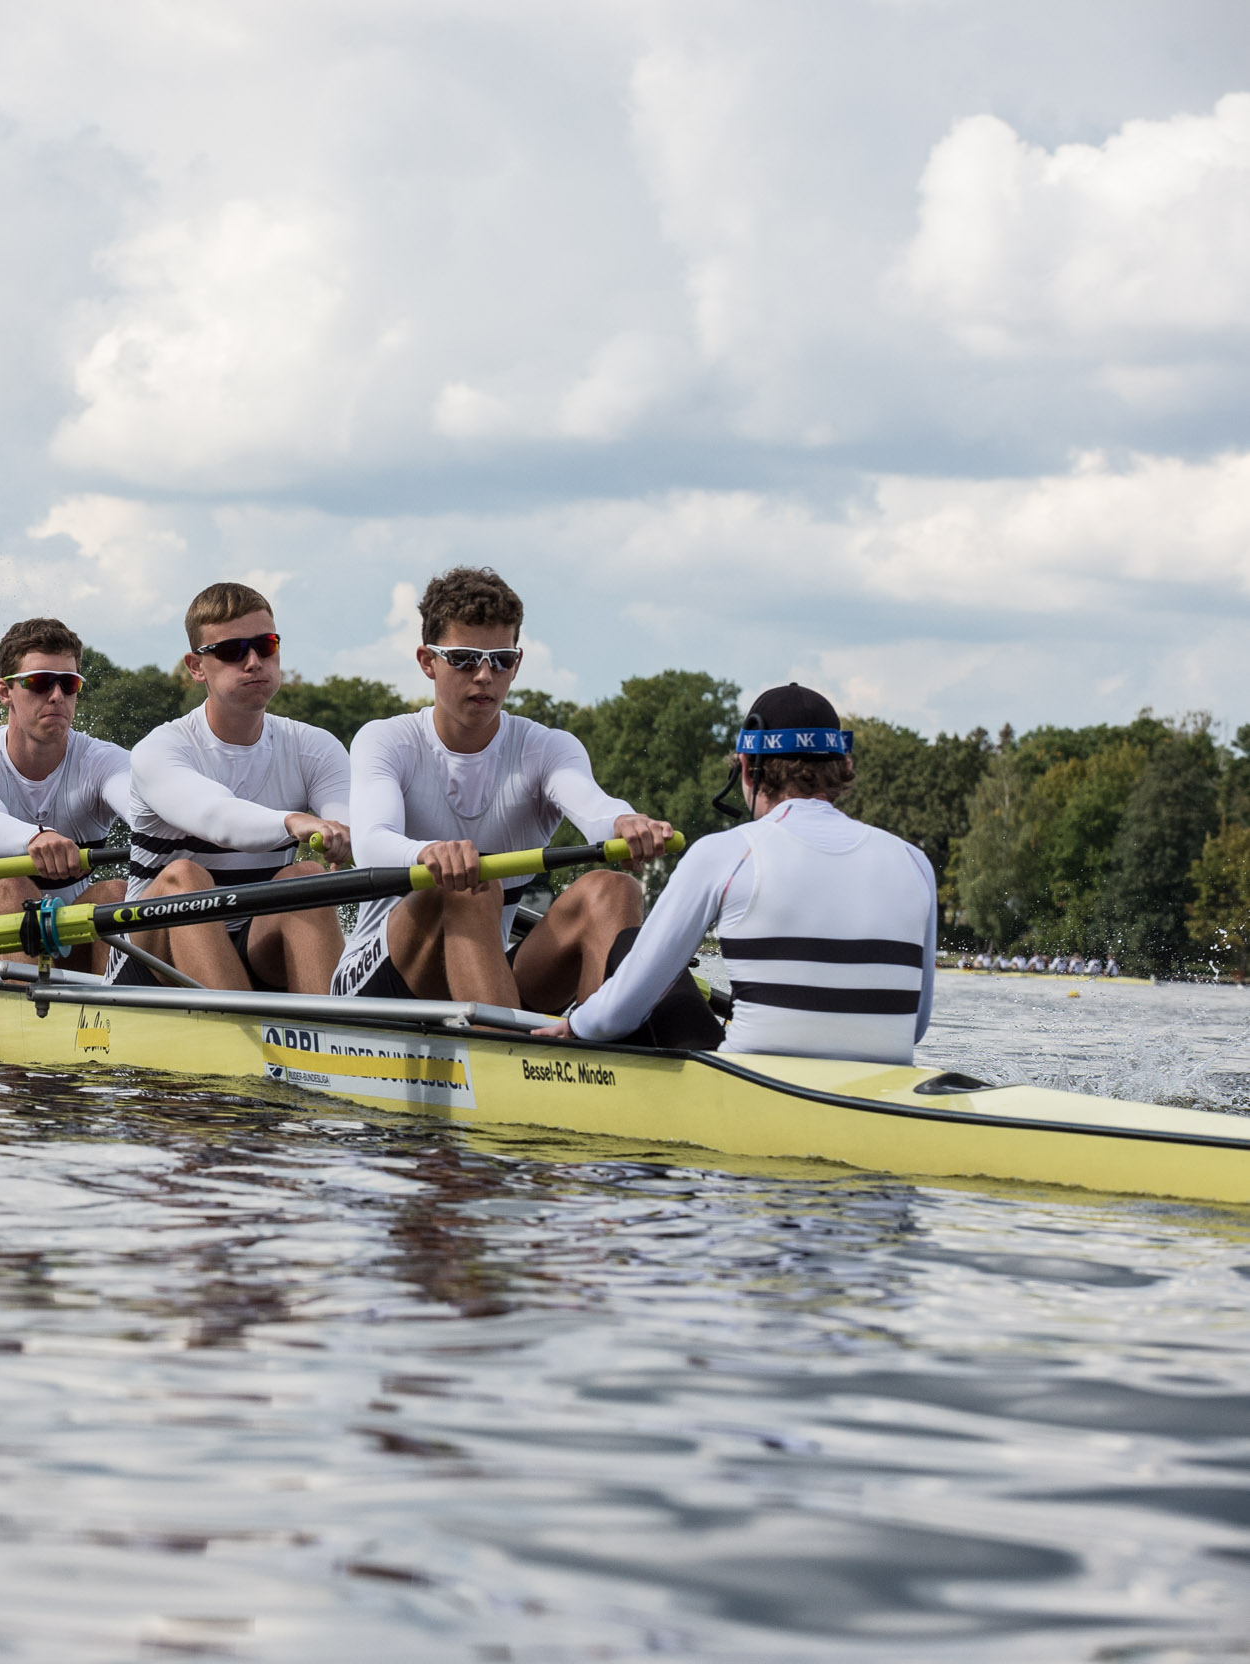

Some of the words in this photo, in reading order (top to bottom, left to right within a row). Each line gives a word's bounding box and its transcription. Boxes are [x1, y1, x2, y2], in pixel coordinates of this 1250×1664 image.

[742, 735, 755, 749] NK
[762, 734, 783, 749] NK
[795, 733, 815, 748] NK
[825, 732, 839, 748] NK
[143, 896, 221, 917] concept
[226, 894, 237, 906] 2
[522, 1059, 576, 1083] Bessel-R.C.
[578, 1062, 616, 1086] Minden
